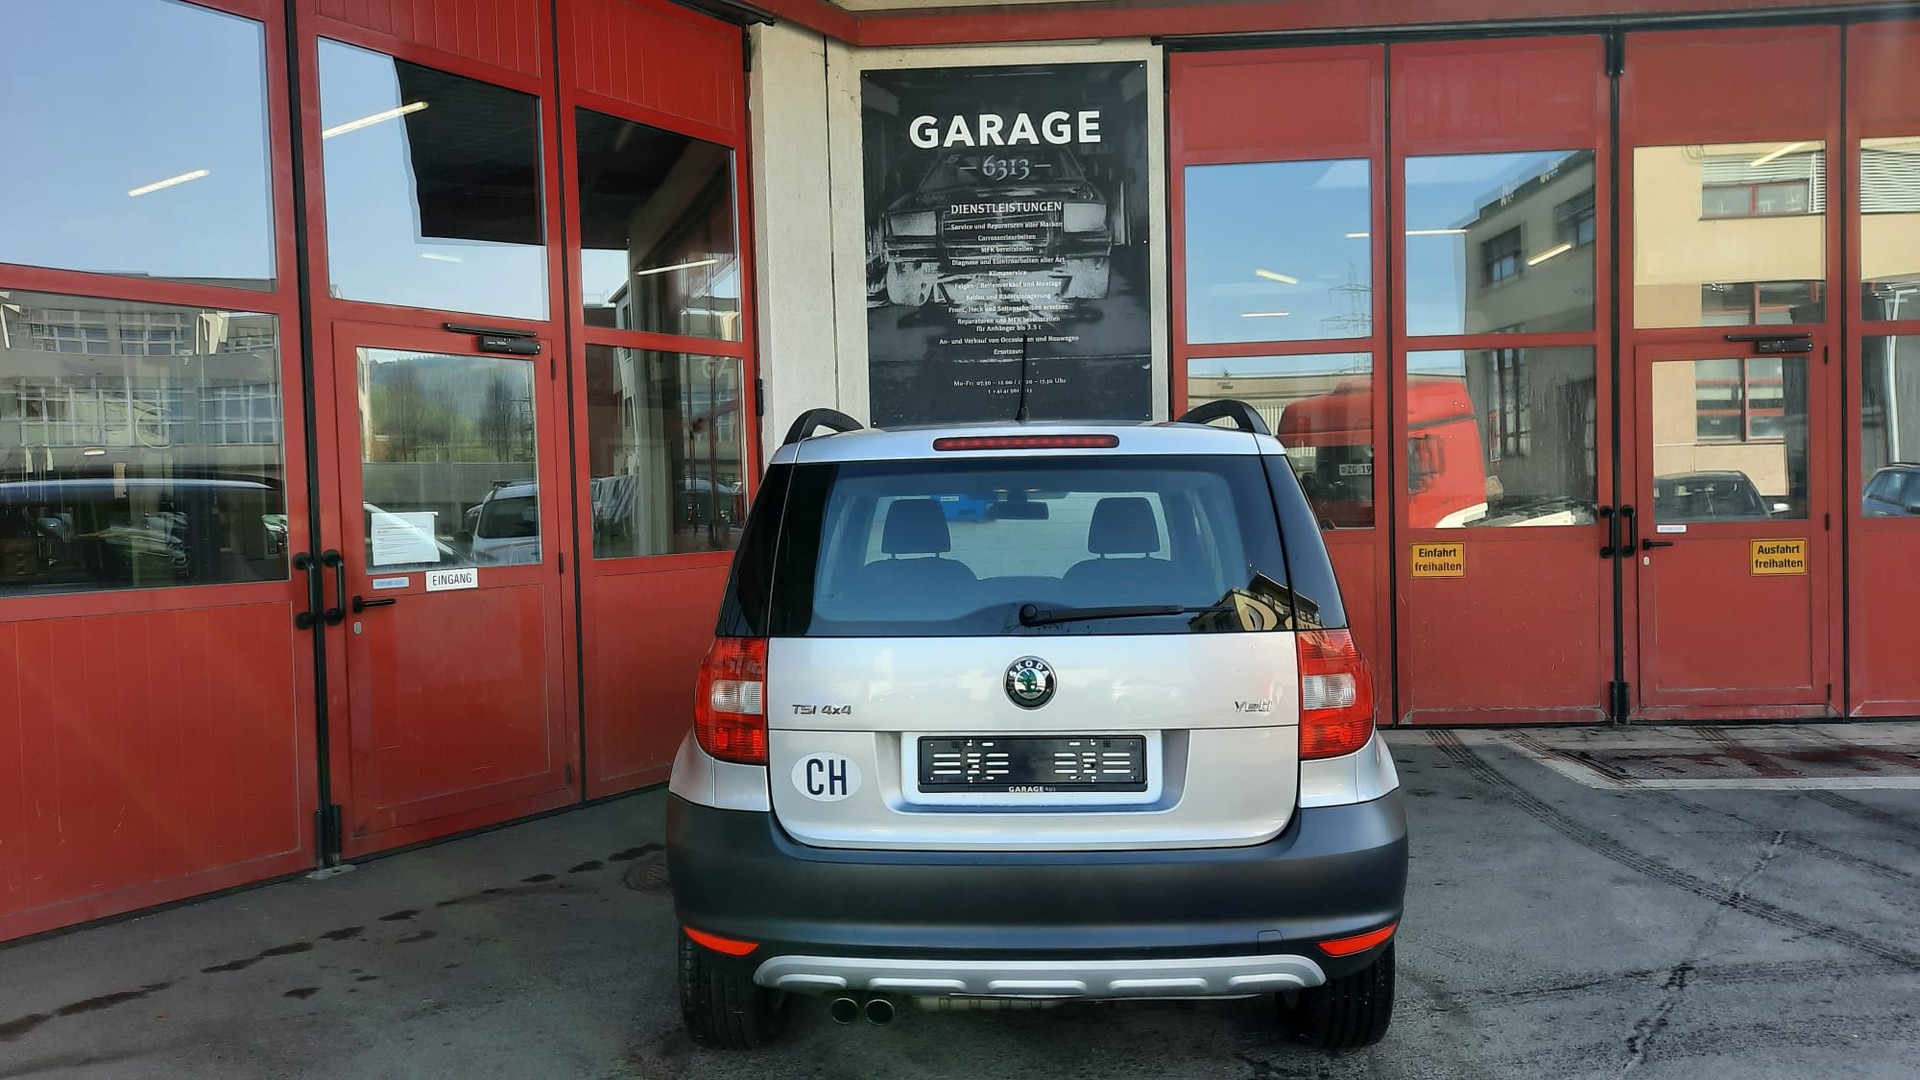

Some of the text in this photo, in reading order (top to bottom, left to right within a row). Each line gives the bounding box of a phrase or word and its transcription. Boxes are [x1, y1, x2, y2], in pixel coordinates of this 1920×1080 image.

[909, 110, 1101, 149] GARAGE
[982, 154, 1030, 181] 6313
[950, 201, 1063, 215] DIENSTLEISTUNGEN
[951, 222, 973, 231] Service
[974, 222, 986, 230] und
[987, 222, 1024, 231] Reparaturen
[1025, 221, 1039, 229] aller
[952, 255, 1066, 268] Diagnose und Elektroarbeiten aller Art
[1023, 280, 1035, 288] und
[986, 324, 1015, 333] Anhänger
[964, 337, 987, 345] Verkauf
[1048, 335, 1080, 343] Neuwagen
[1418, 547, 1457, 558] Einfahrt
[1757, 544, 1800, 555] Ausfahrt
[1414, 561, 1462, 572] freihalten
[1755, 558, 1803, 569] freihalten
[432, 572, 472, 586] EINGANG
[792, 704, 852, 715] TSI 4x4
[1234, 699, 1272, 713] Yeti
[806, 758, 847, 796] CH
[1008, 785, 1044, 793] GARAGE
